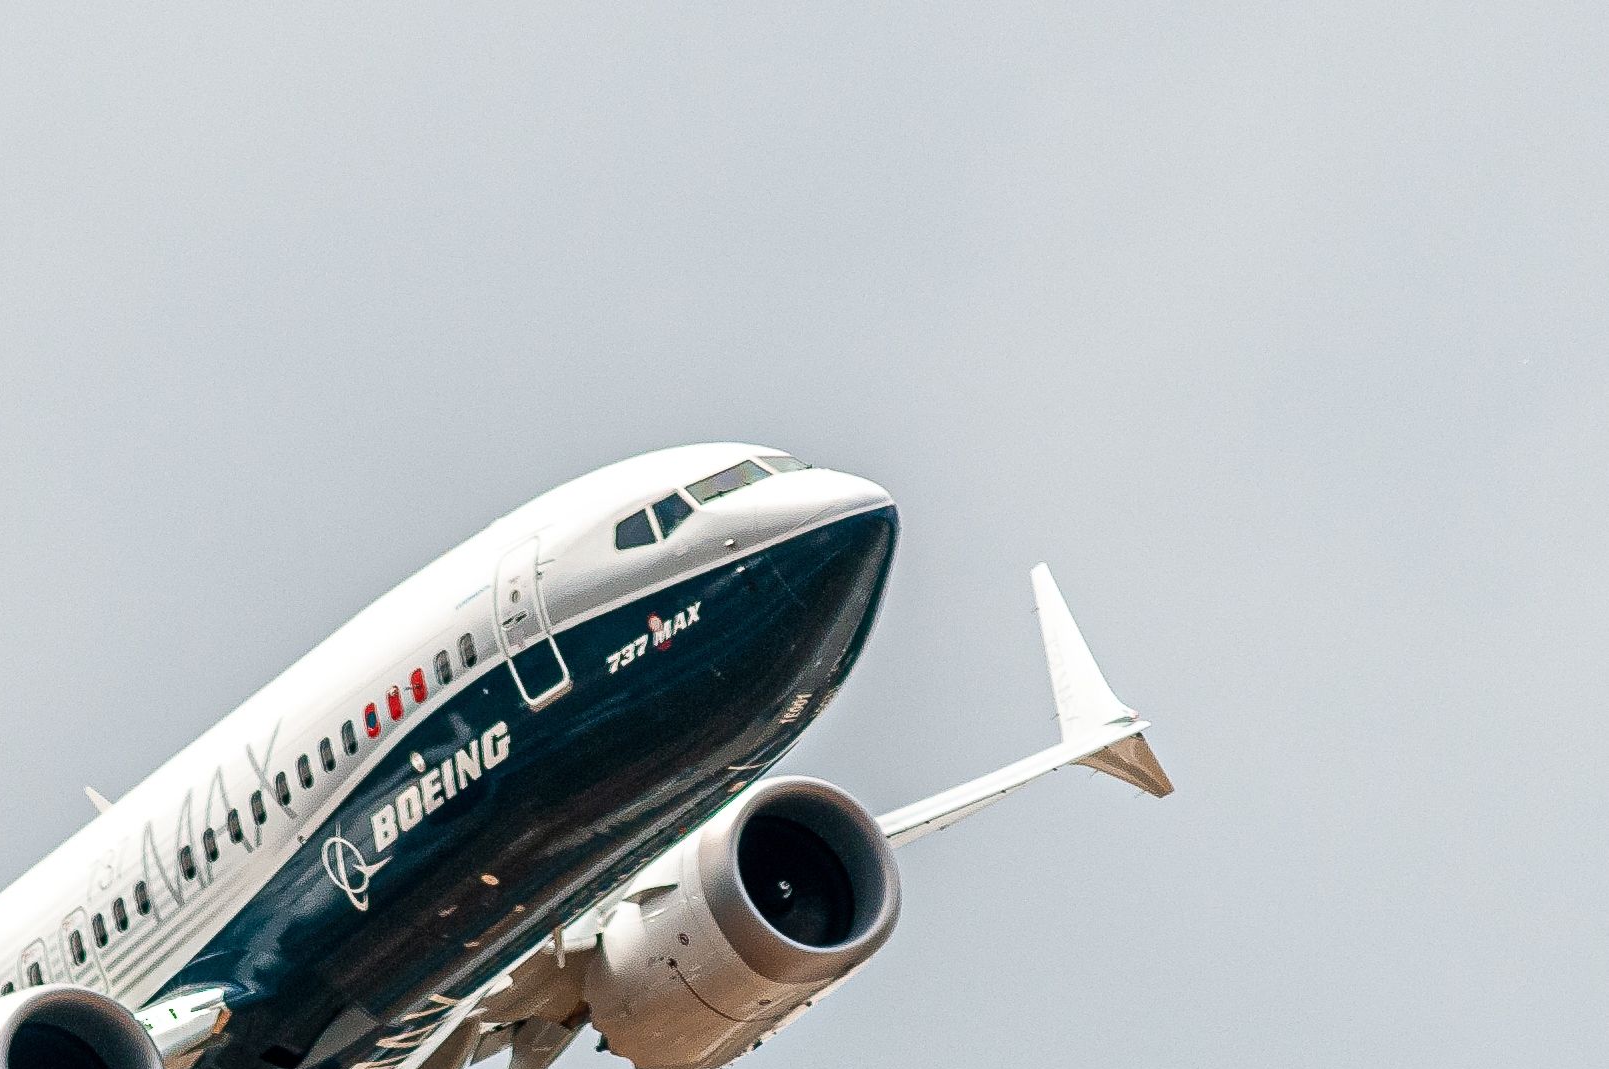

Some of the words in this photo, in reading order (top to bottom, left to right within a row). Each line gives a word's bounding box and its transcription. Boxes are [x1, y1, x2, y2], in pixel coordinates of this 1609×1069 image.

[606, 634, 648, 674] 737
[653, 601, 702, 647] MAX
[143, 716, 304, 922] MAX
[370, 721, 511, 853] BOEING
